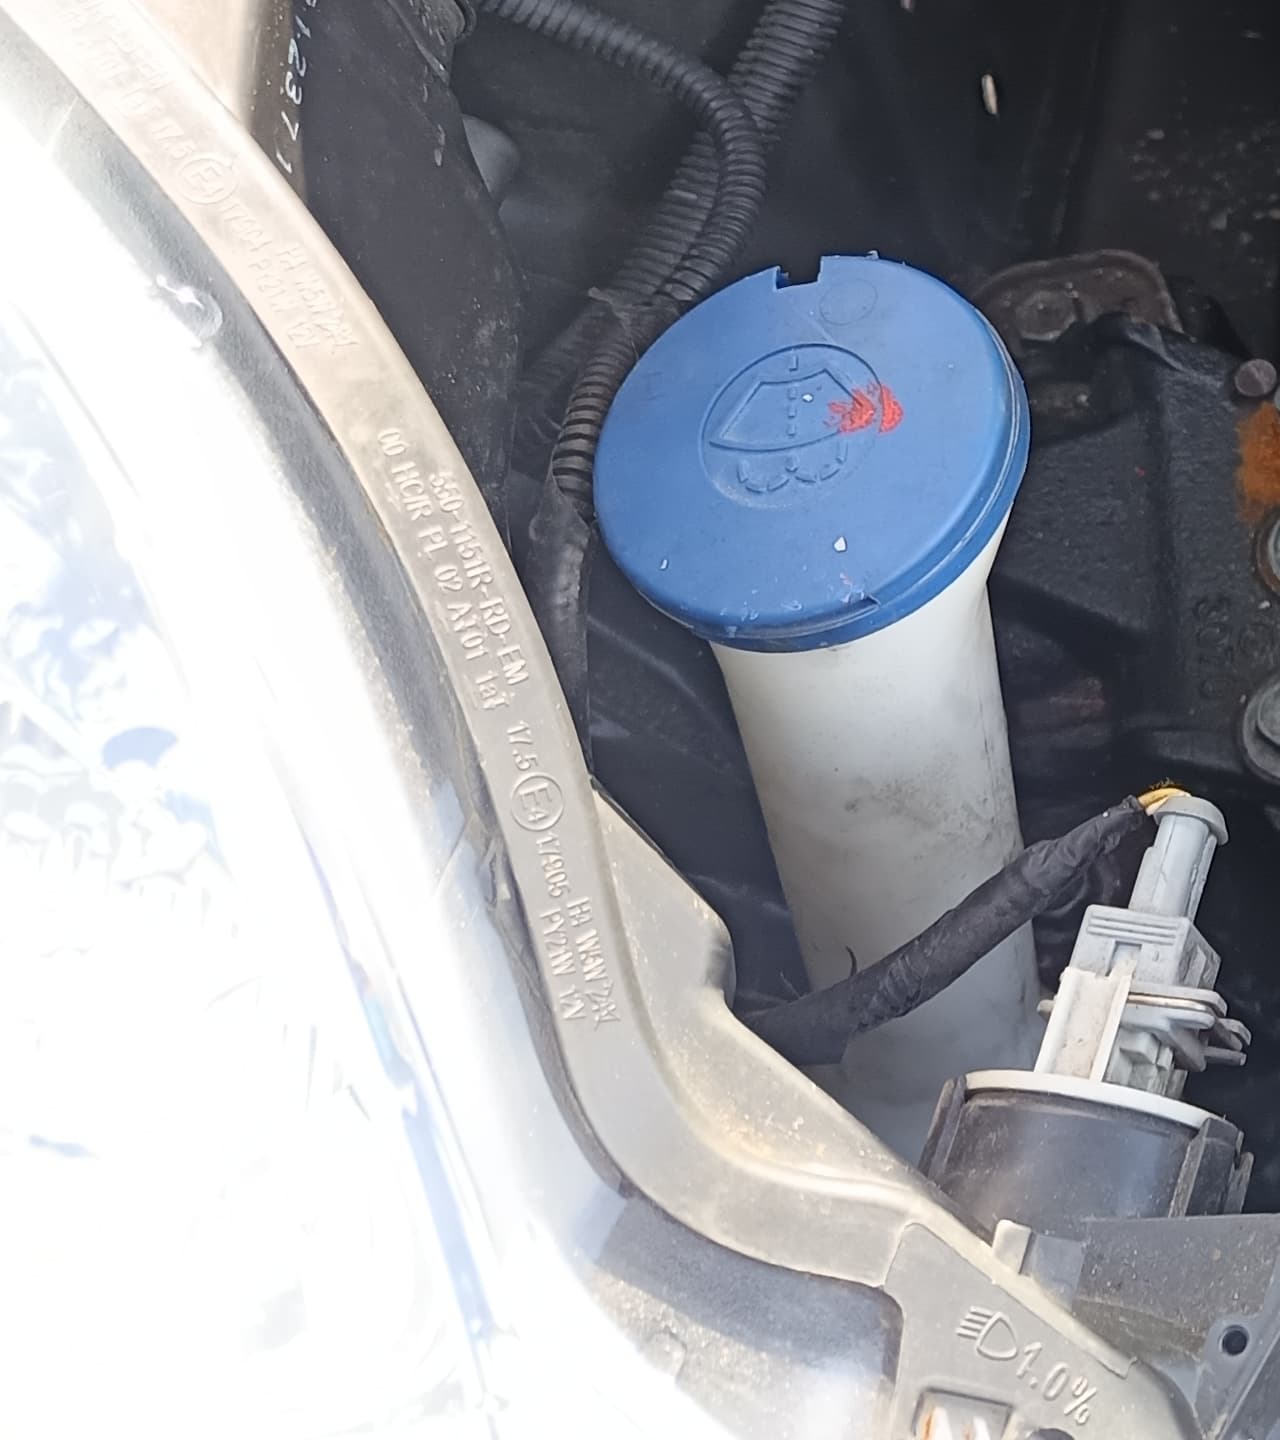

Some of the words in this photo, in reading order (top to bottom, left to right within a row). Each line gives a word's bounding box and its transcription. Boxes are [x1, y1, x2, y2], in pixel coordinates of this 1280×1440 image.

[434, 563, 464, 592] 02
[507, 720, 539, 772] 17.5
[1015, 1341, 1097, 1426] 1.0%
